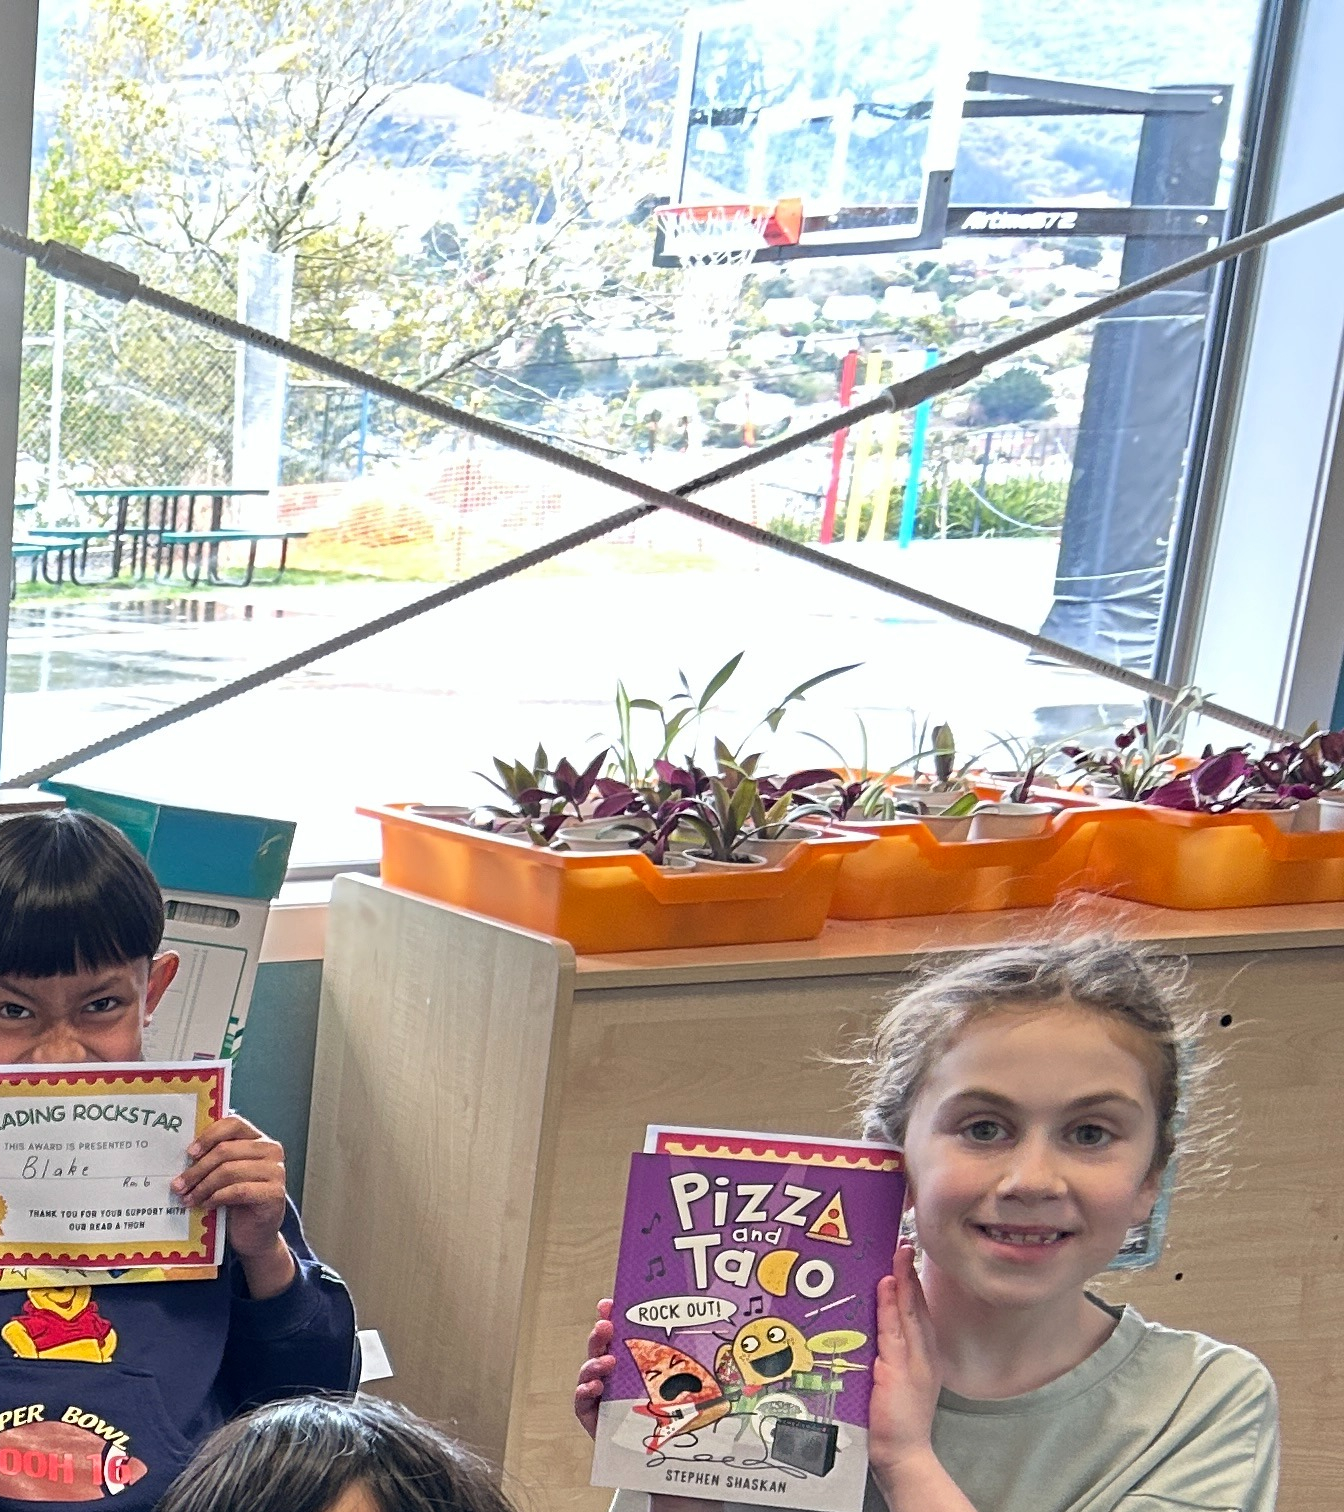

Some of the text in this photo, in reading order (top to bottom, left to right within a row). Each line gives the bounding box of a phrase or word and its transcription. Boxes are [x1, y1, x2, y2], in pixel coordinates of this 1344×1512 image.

[72, 1103, 183, 1133] ROCKSTAR
[4, 1140, 149, 1151] THIS AWARD IS PRESENTED TO
[22, 1155, 89, 1180] Blake
[29, 1209, 57, 1218] THANK
[80, 1210, 97, 1218] FOR
[100, 1209, 122, 1217] YOUR
[125, 1207, 163, 1216] SUPPORT
[166, 1206, 186, 1215] WITH
[69, 1222, 86, 1231] OUR
[89, 1222, 112, 1230] READ
[115, 1221, 121, 1230] A
[732, 1225, 782, 1246] and
[673, 1233, 835, 1298] Taco
[638, 1300, 722, 1322] ROCK OUT!
[61, 1405, 131, 1451] BOWL
[89, 1453, 134, 1485] 16
[665, 1468, 787, 1494] STEPHEN SHASKAN
